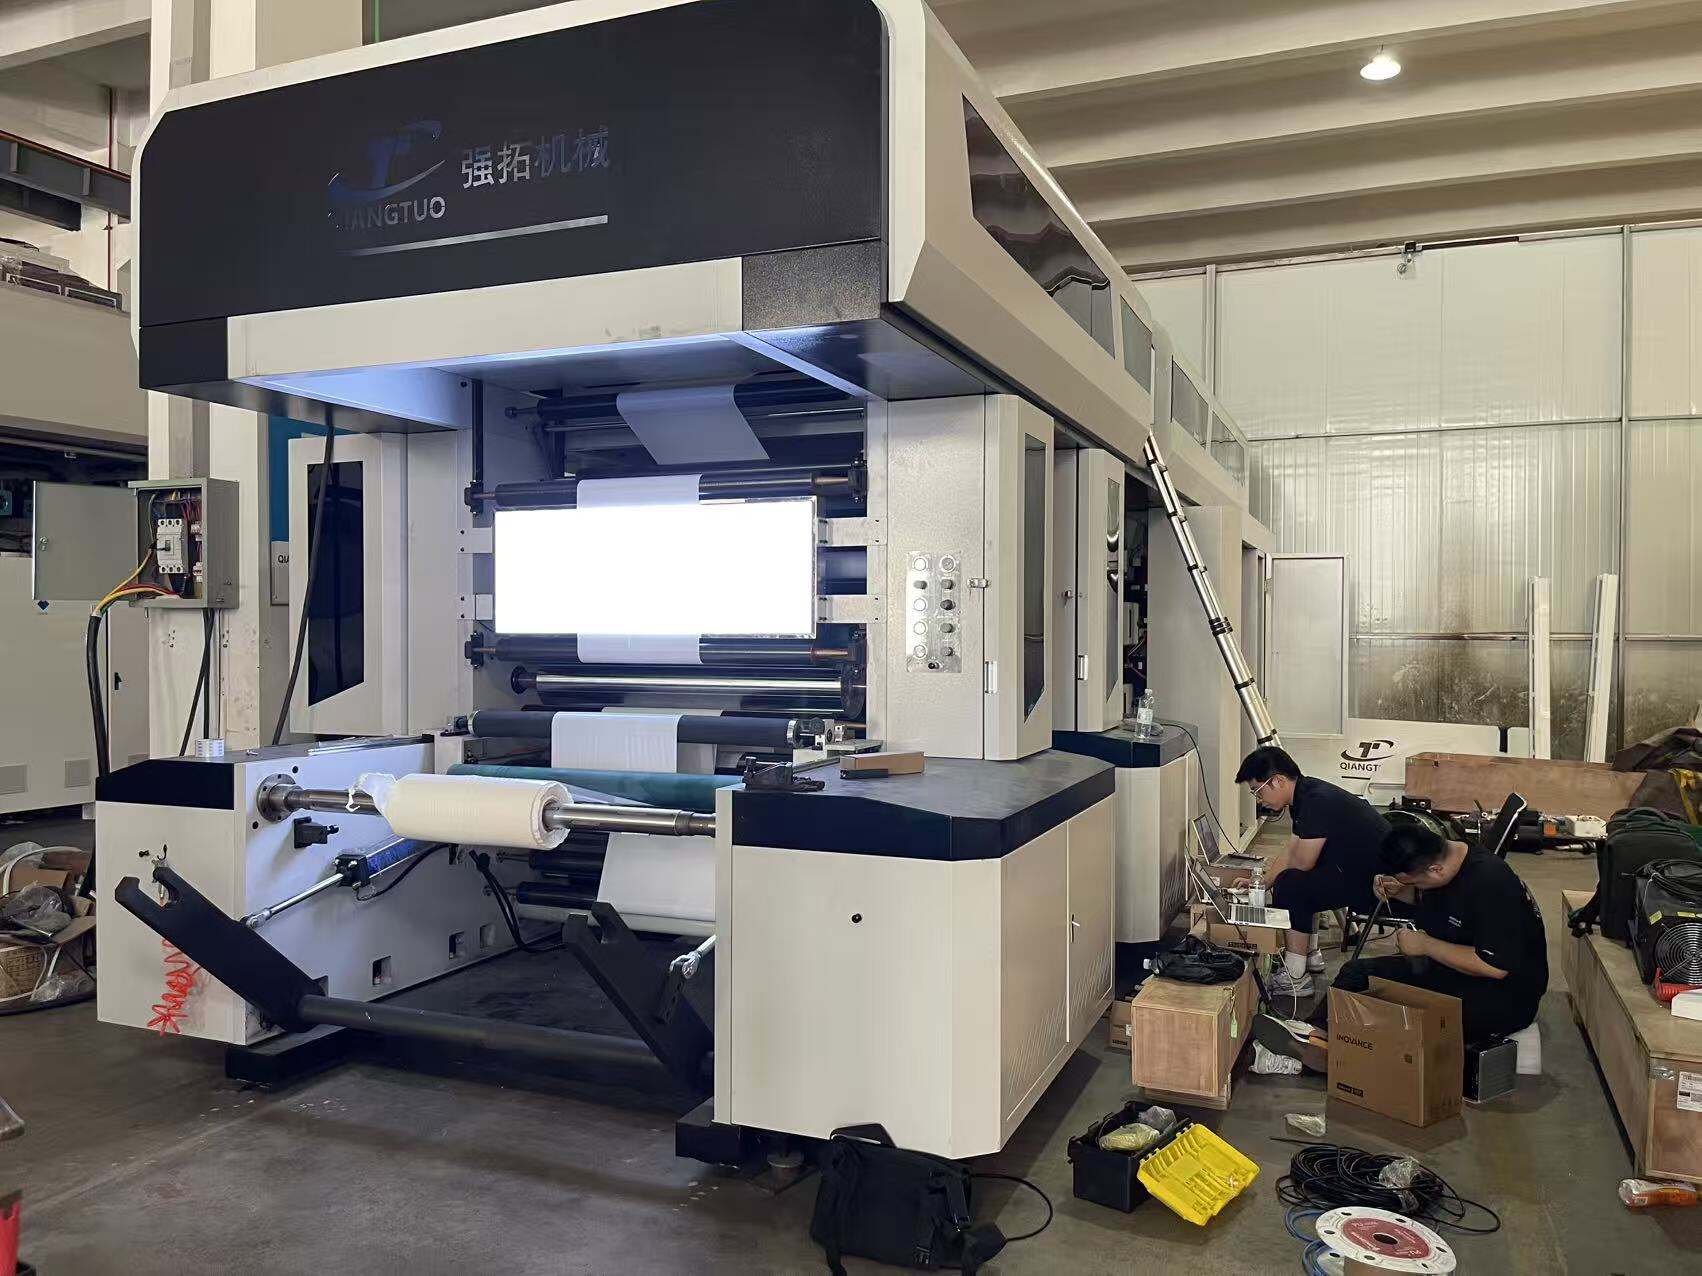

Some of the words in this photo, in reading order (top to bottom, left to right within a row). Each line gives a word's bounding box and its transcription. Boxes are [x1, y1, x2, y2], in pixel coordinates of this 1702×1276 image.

[461, 127, 610, 189] 强拓机械
[330, 195, 447, 231] IANGTUO
[1339, 761, 1382, 772] QIANGT
[1336, 1033, 1374, 1051] INOVANCE
